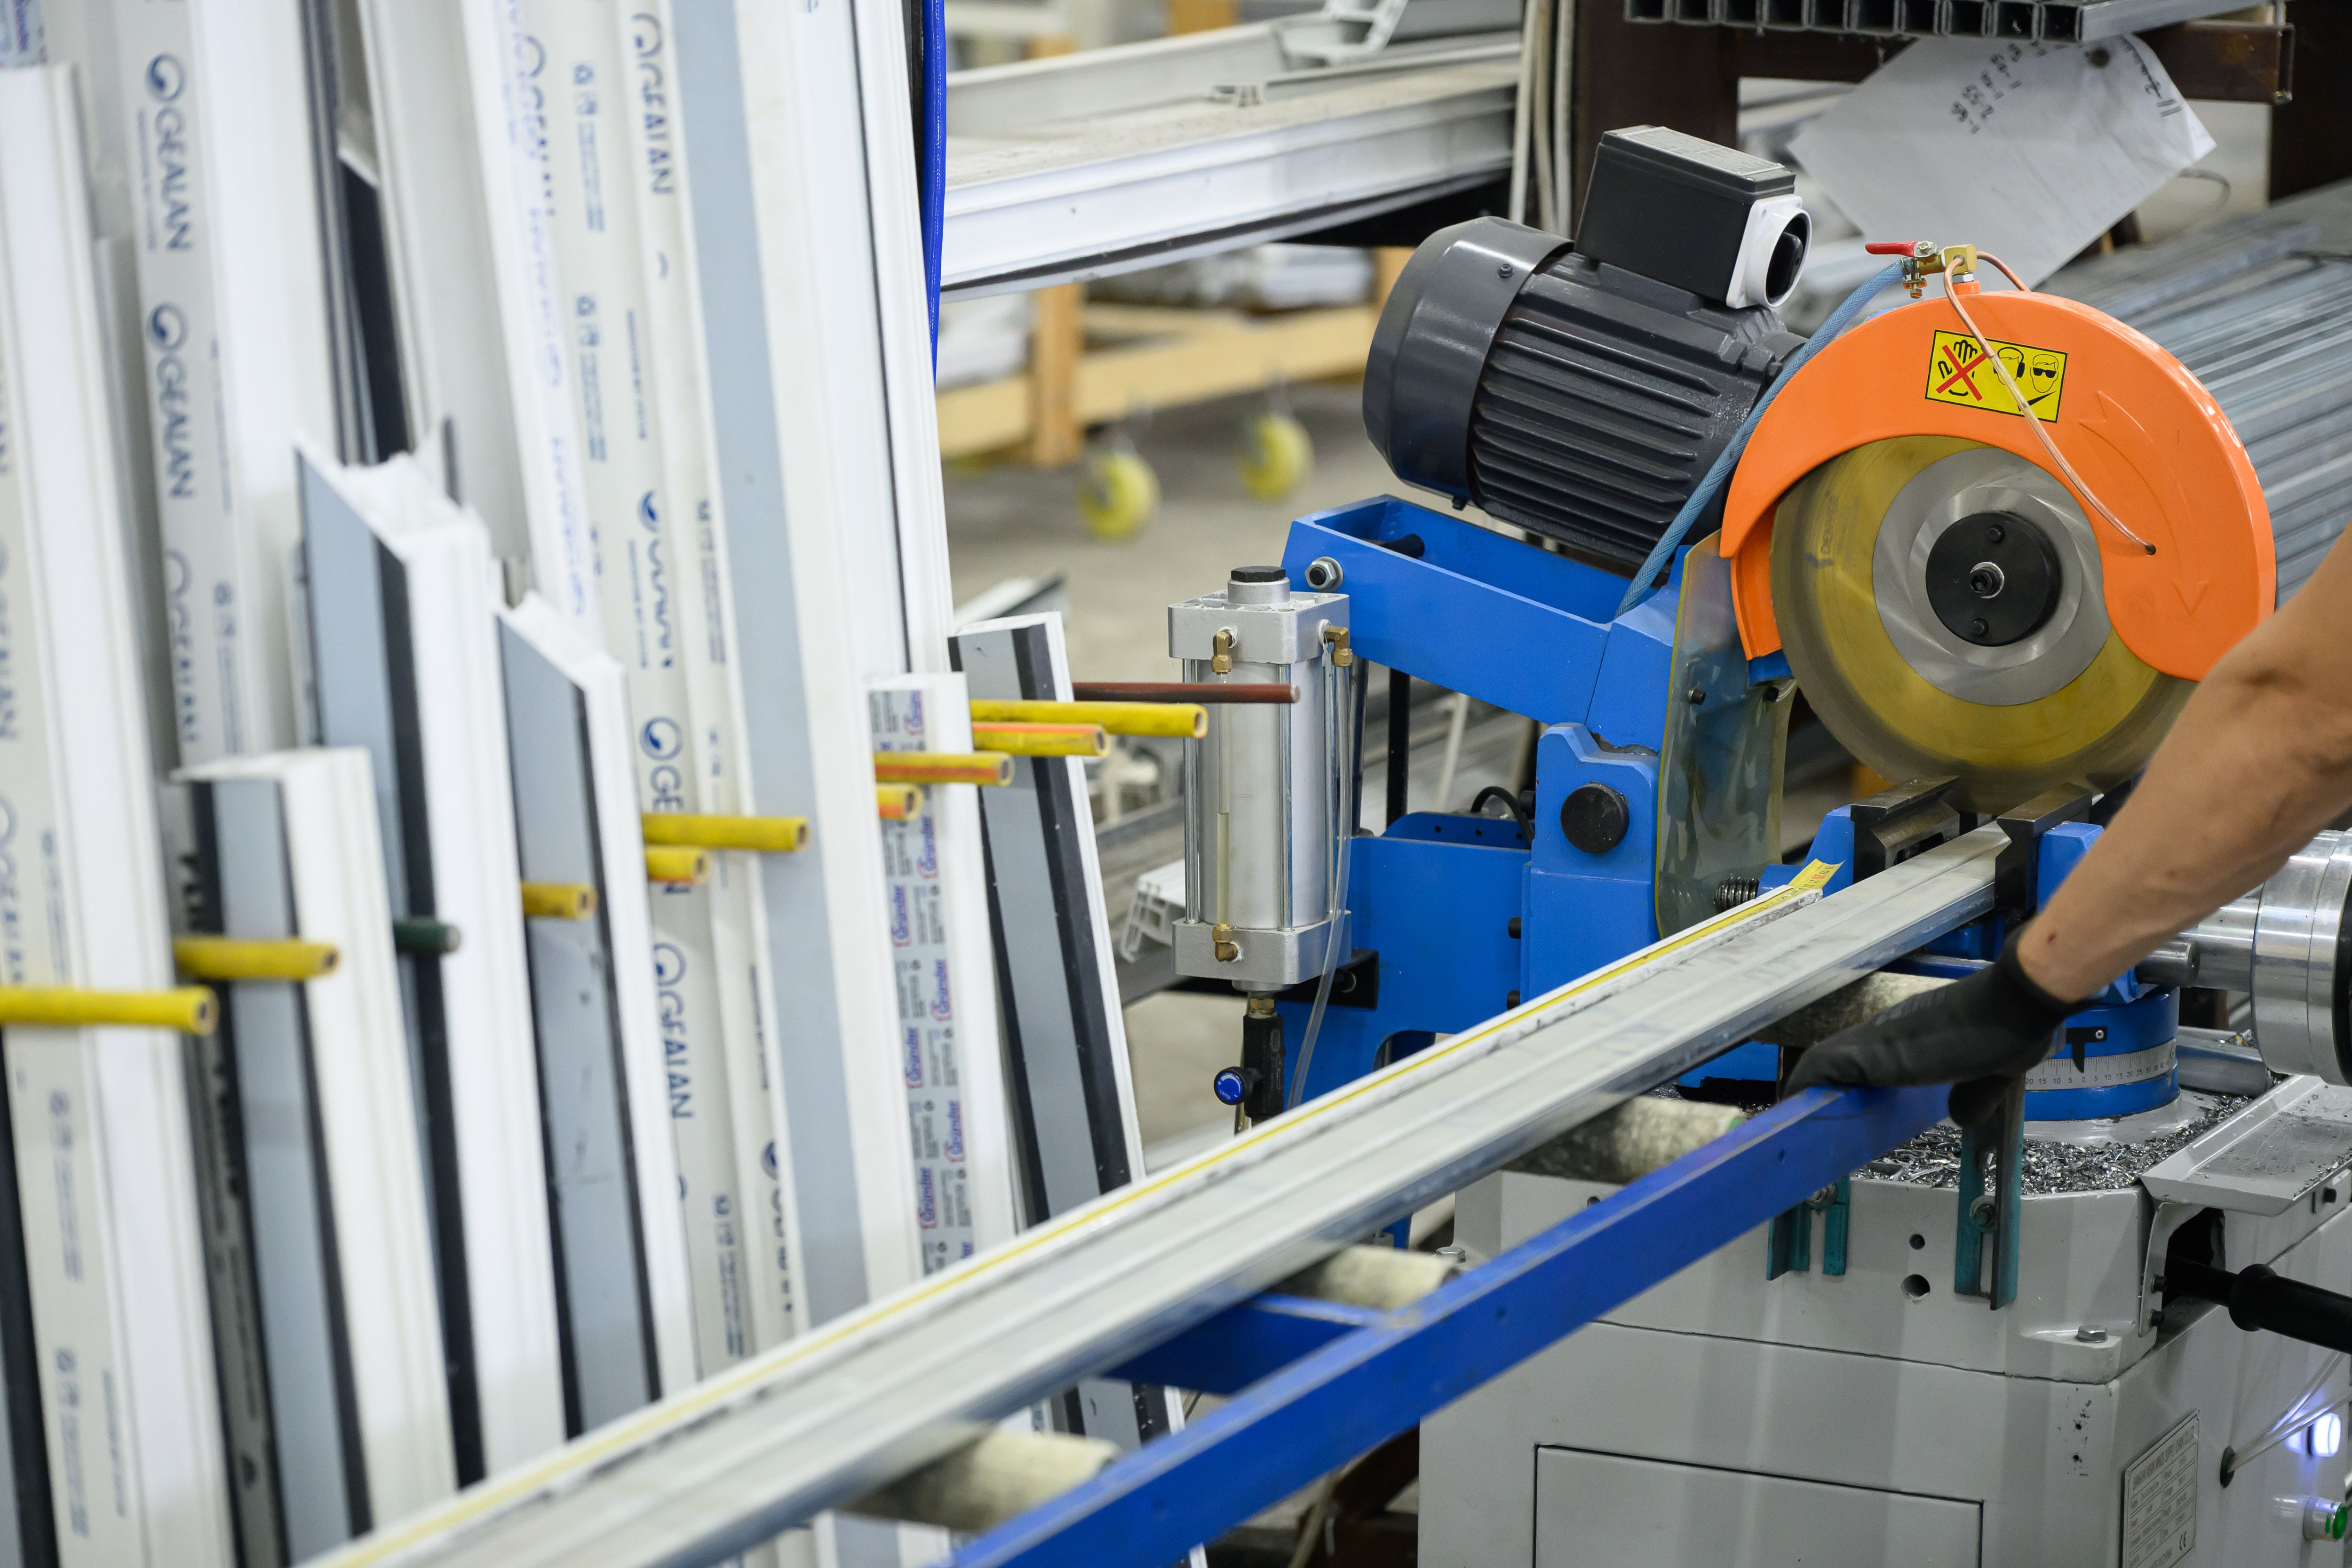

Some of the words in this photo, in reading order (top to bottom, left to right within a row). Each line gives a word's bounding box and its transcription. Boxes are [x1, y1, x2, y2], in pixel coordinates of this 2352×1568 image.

[154, 107, 192, 251] GEALAN
[157, 355, 193, 498] GEALAN
[2165, 1442, 2175, 1464] SUPPLY
